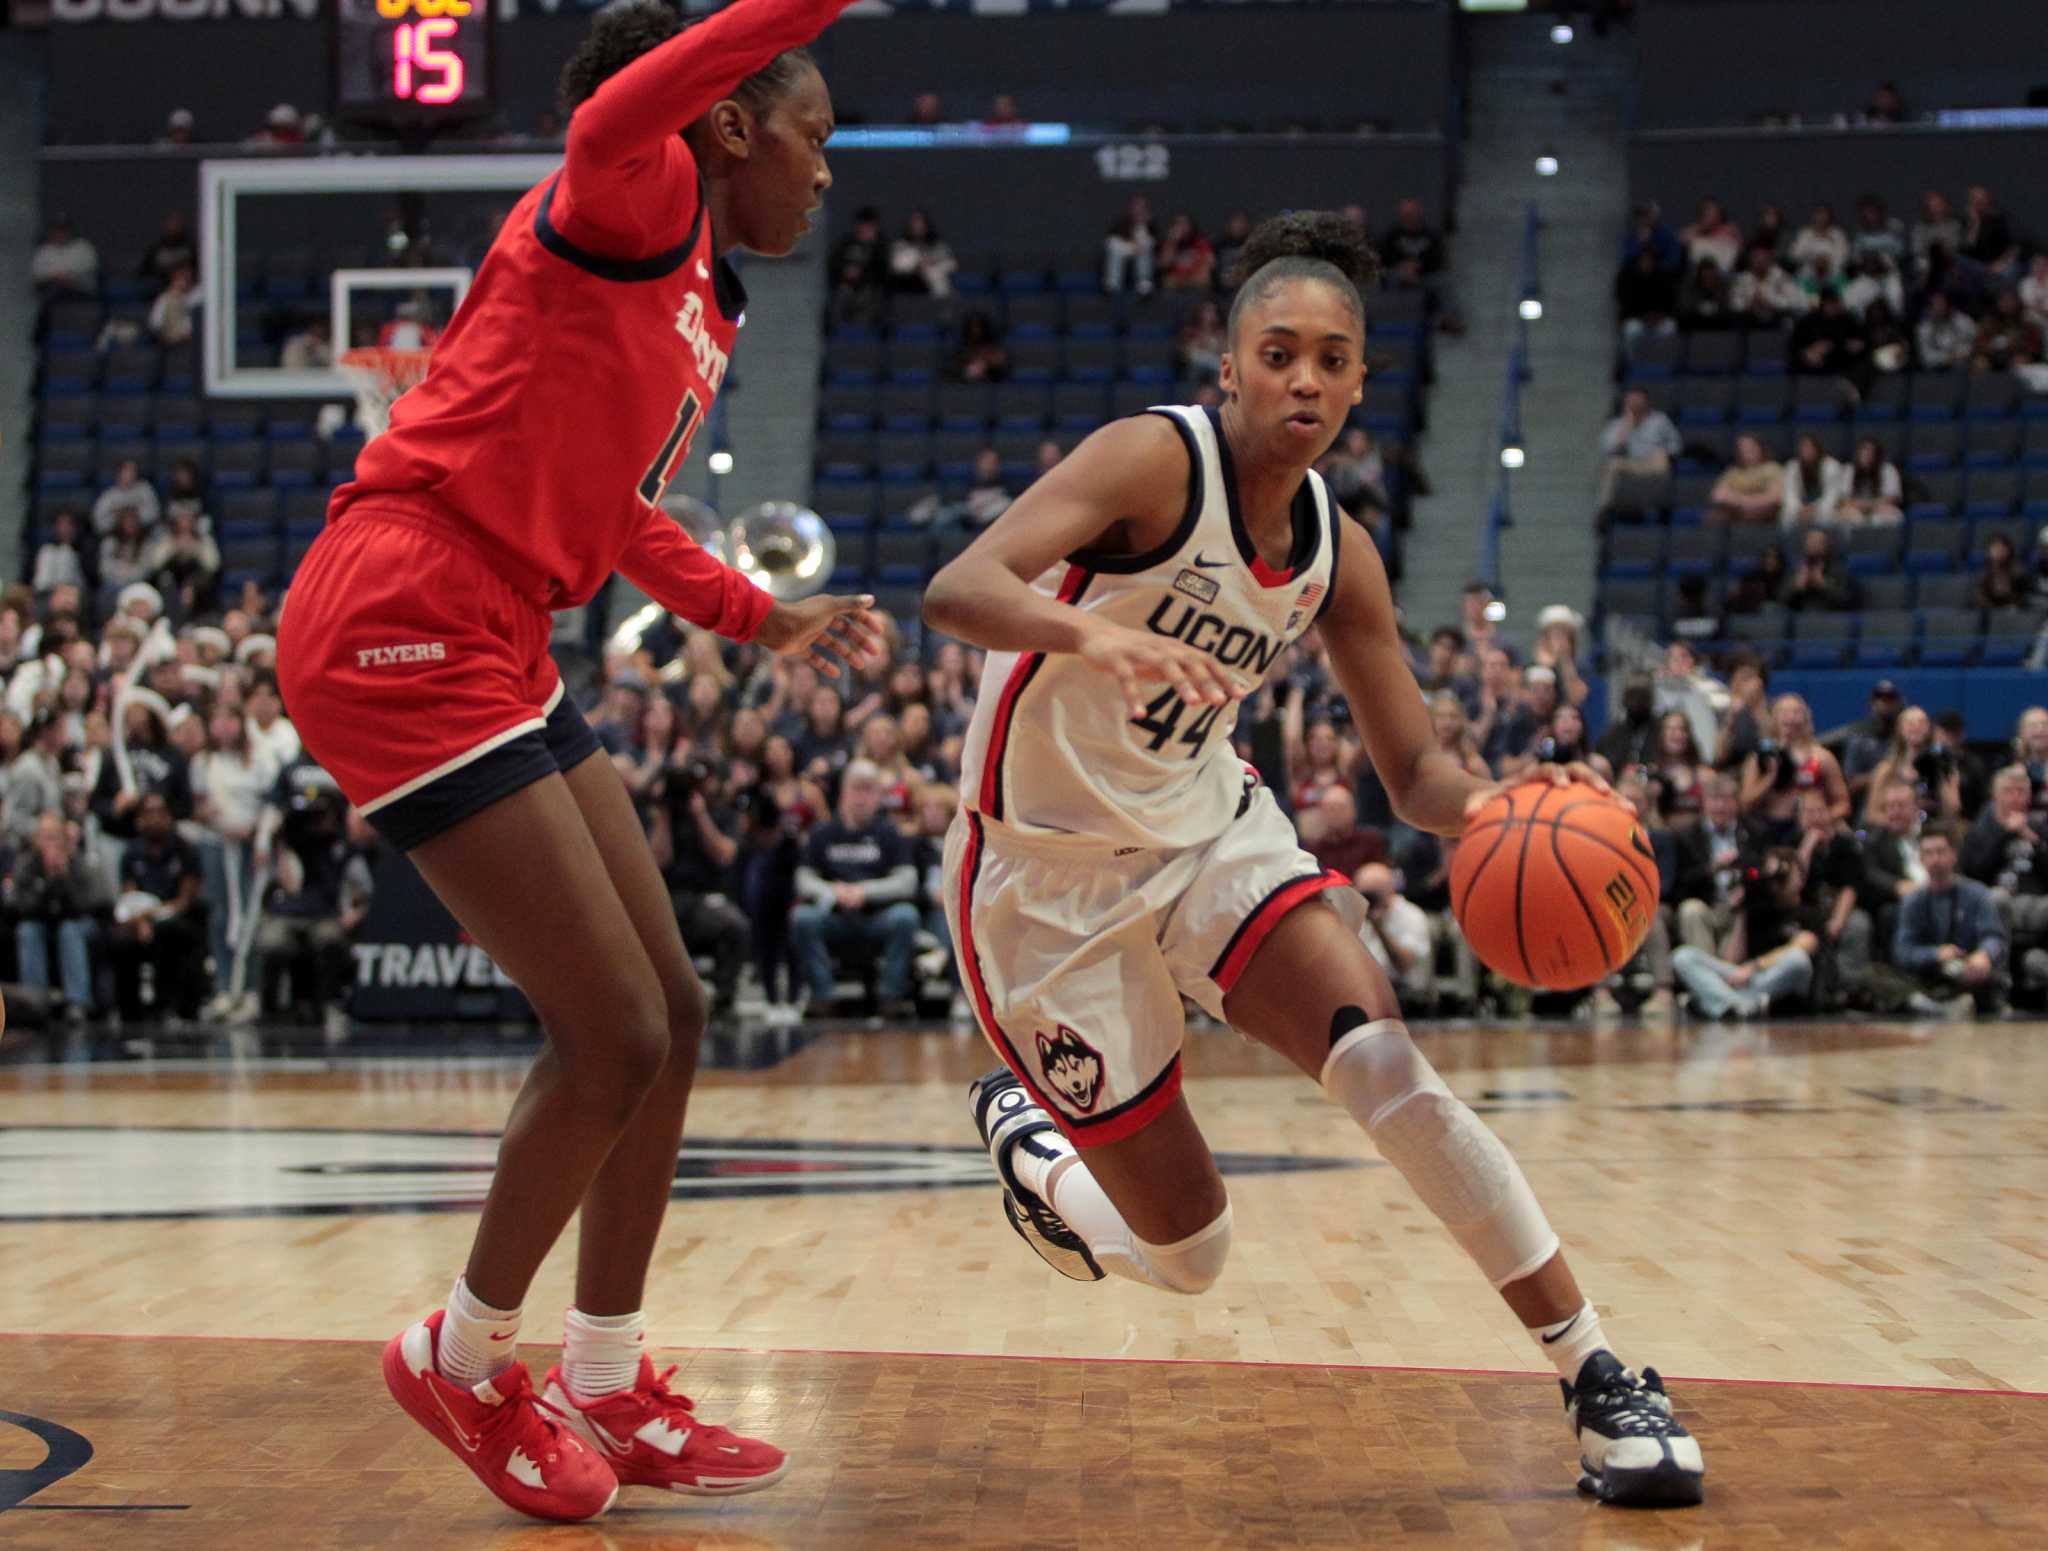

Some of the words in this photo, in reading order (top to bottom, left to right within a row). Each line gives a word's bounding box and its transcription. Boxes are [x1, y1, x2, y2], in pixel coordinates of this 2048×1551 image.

[393, 18, 464, 103] 15
[1096, 144, 1168, 179] 122
[356, 641, 446, 668] FLYERS
[1147, 595, 1290, 675] UCON
[1131, 687, 1231, 759] 44
